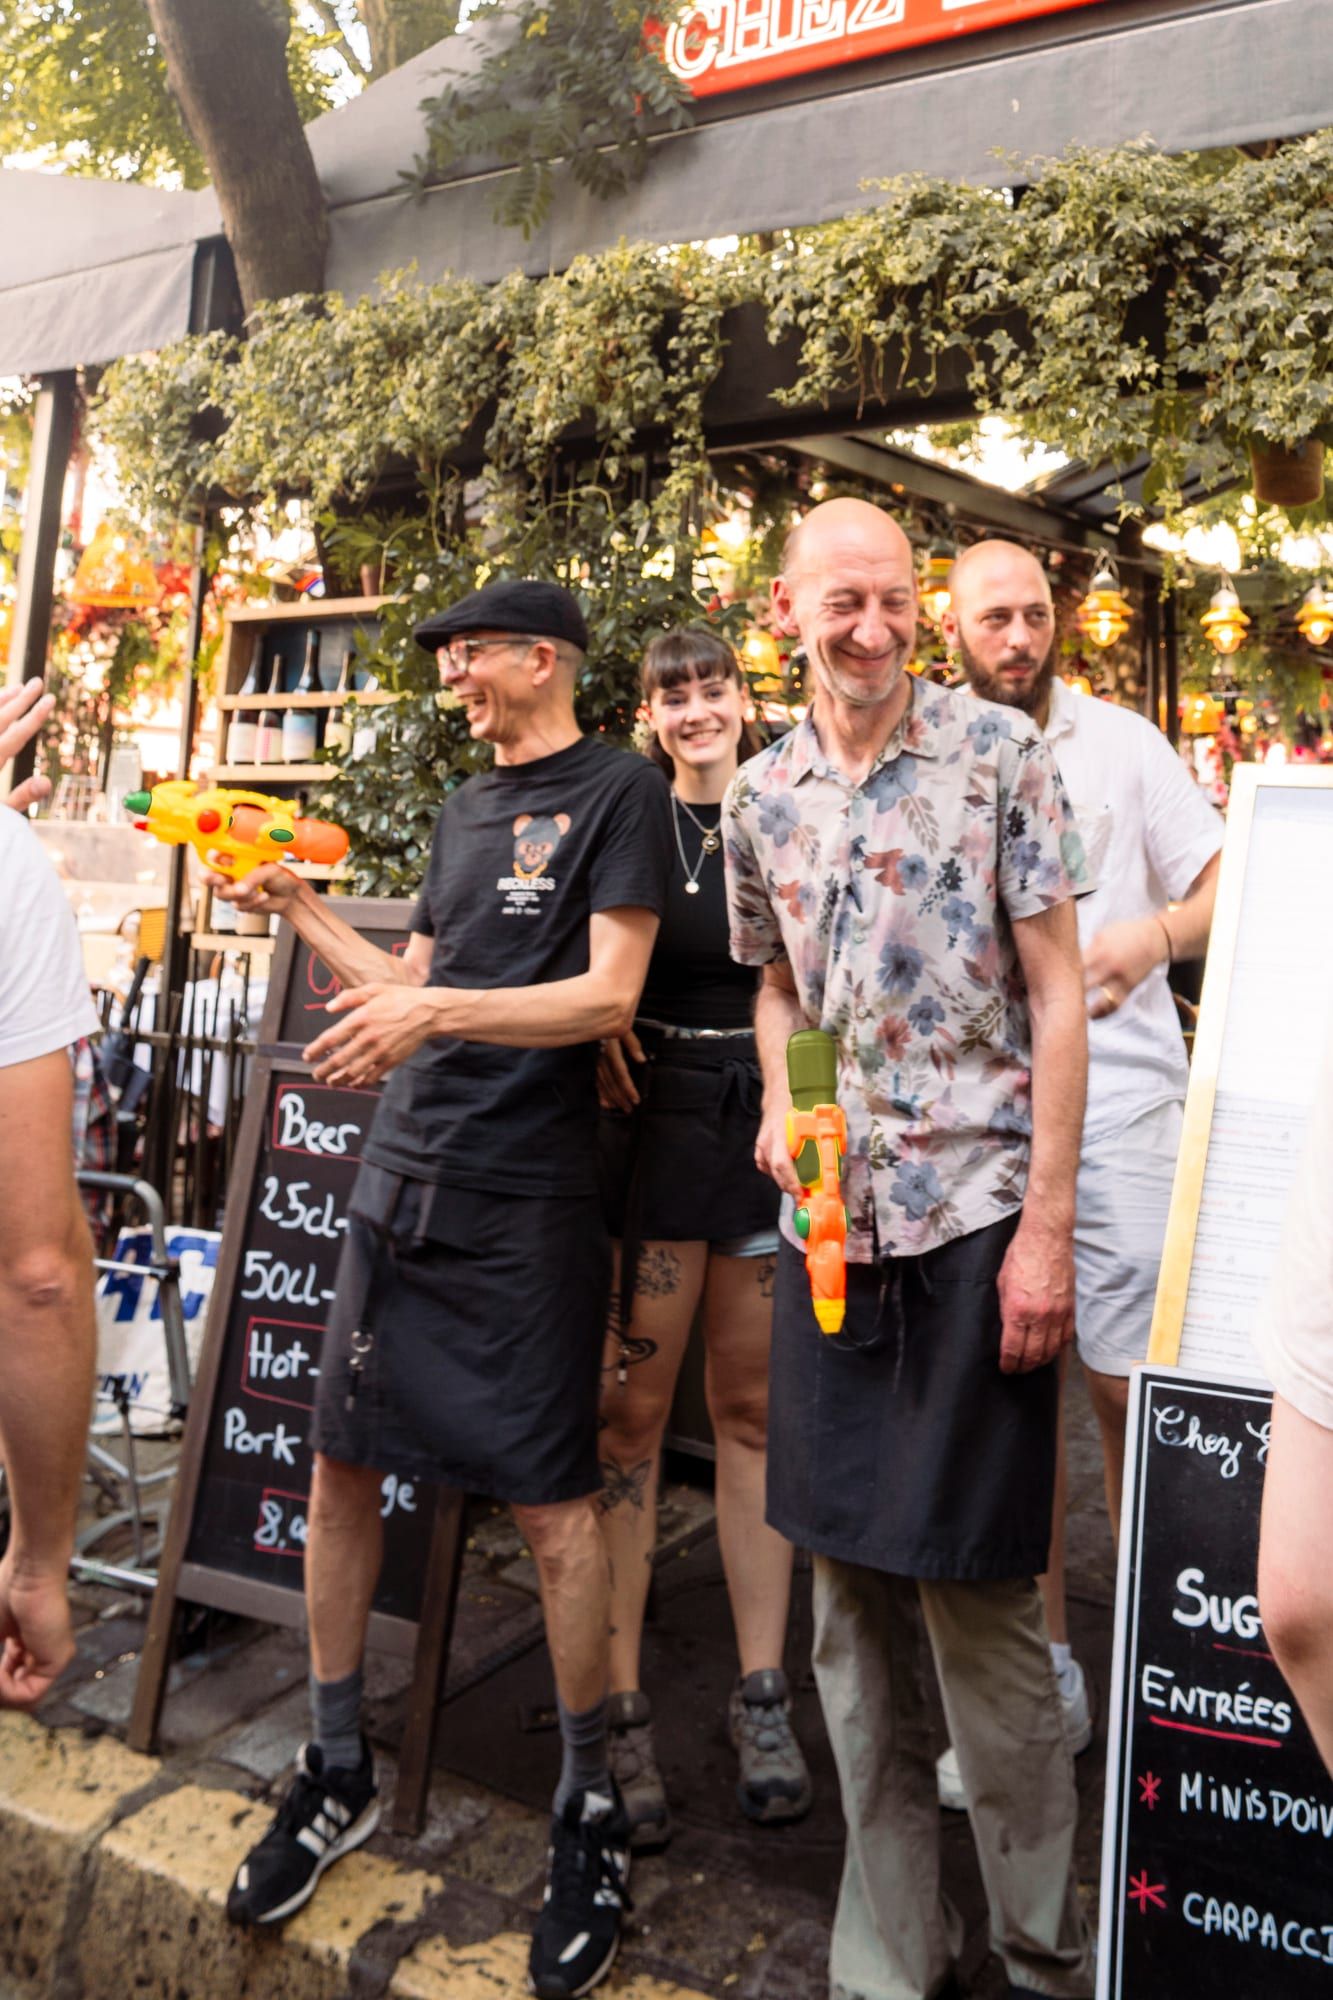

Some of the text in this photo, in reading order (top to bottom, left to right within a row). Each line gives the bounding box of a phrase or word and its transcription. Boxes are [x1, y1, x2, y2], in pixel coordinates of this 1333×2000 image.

[279, 1093, 361, 1155] Beer
[224, 1406, 301, 1465] Pork
[1141, 1663, 1291, 1734] ENTRÉES
